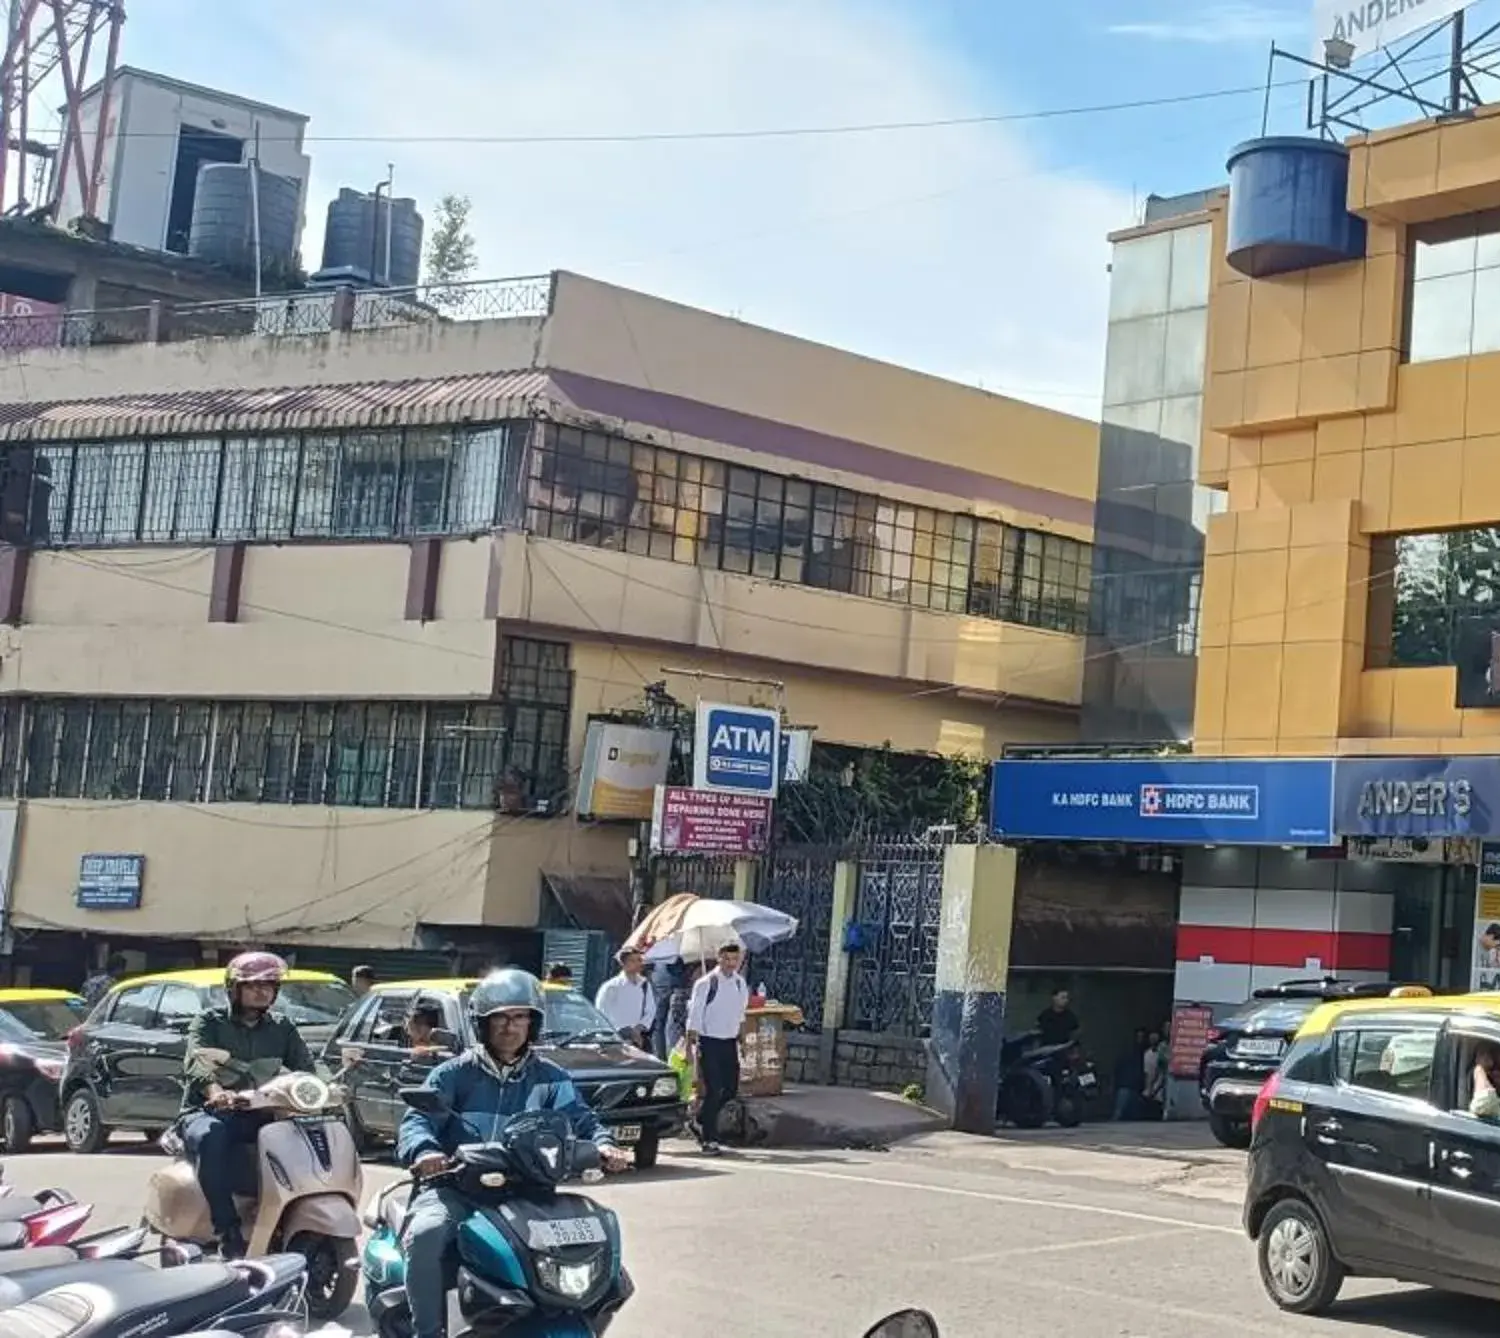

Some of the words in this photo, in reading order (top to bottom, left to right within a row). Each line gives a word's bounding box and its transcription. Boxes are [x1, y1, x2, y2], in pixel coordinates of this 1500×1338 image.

[712, 725, 770, 754] ATM
[669, 790, 686, 801] ALL
[1070, 793, 1098, 807] HDFC
[1101, 793, 1133, 807] BANK
[1166, 793, 1204, 810] HDFC
[1208, 794, 1250, 811] BANK
[1357, 779, 1472, 817] ANDER'S
[667, 803, 715, 816] REPAIRING
[718, 807, 740, 818] DONE
